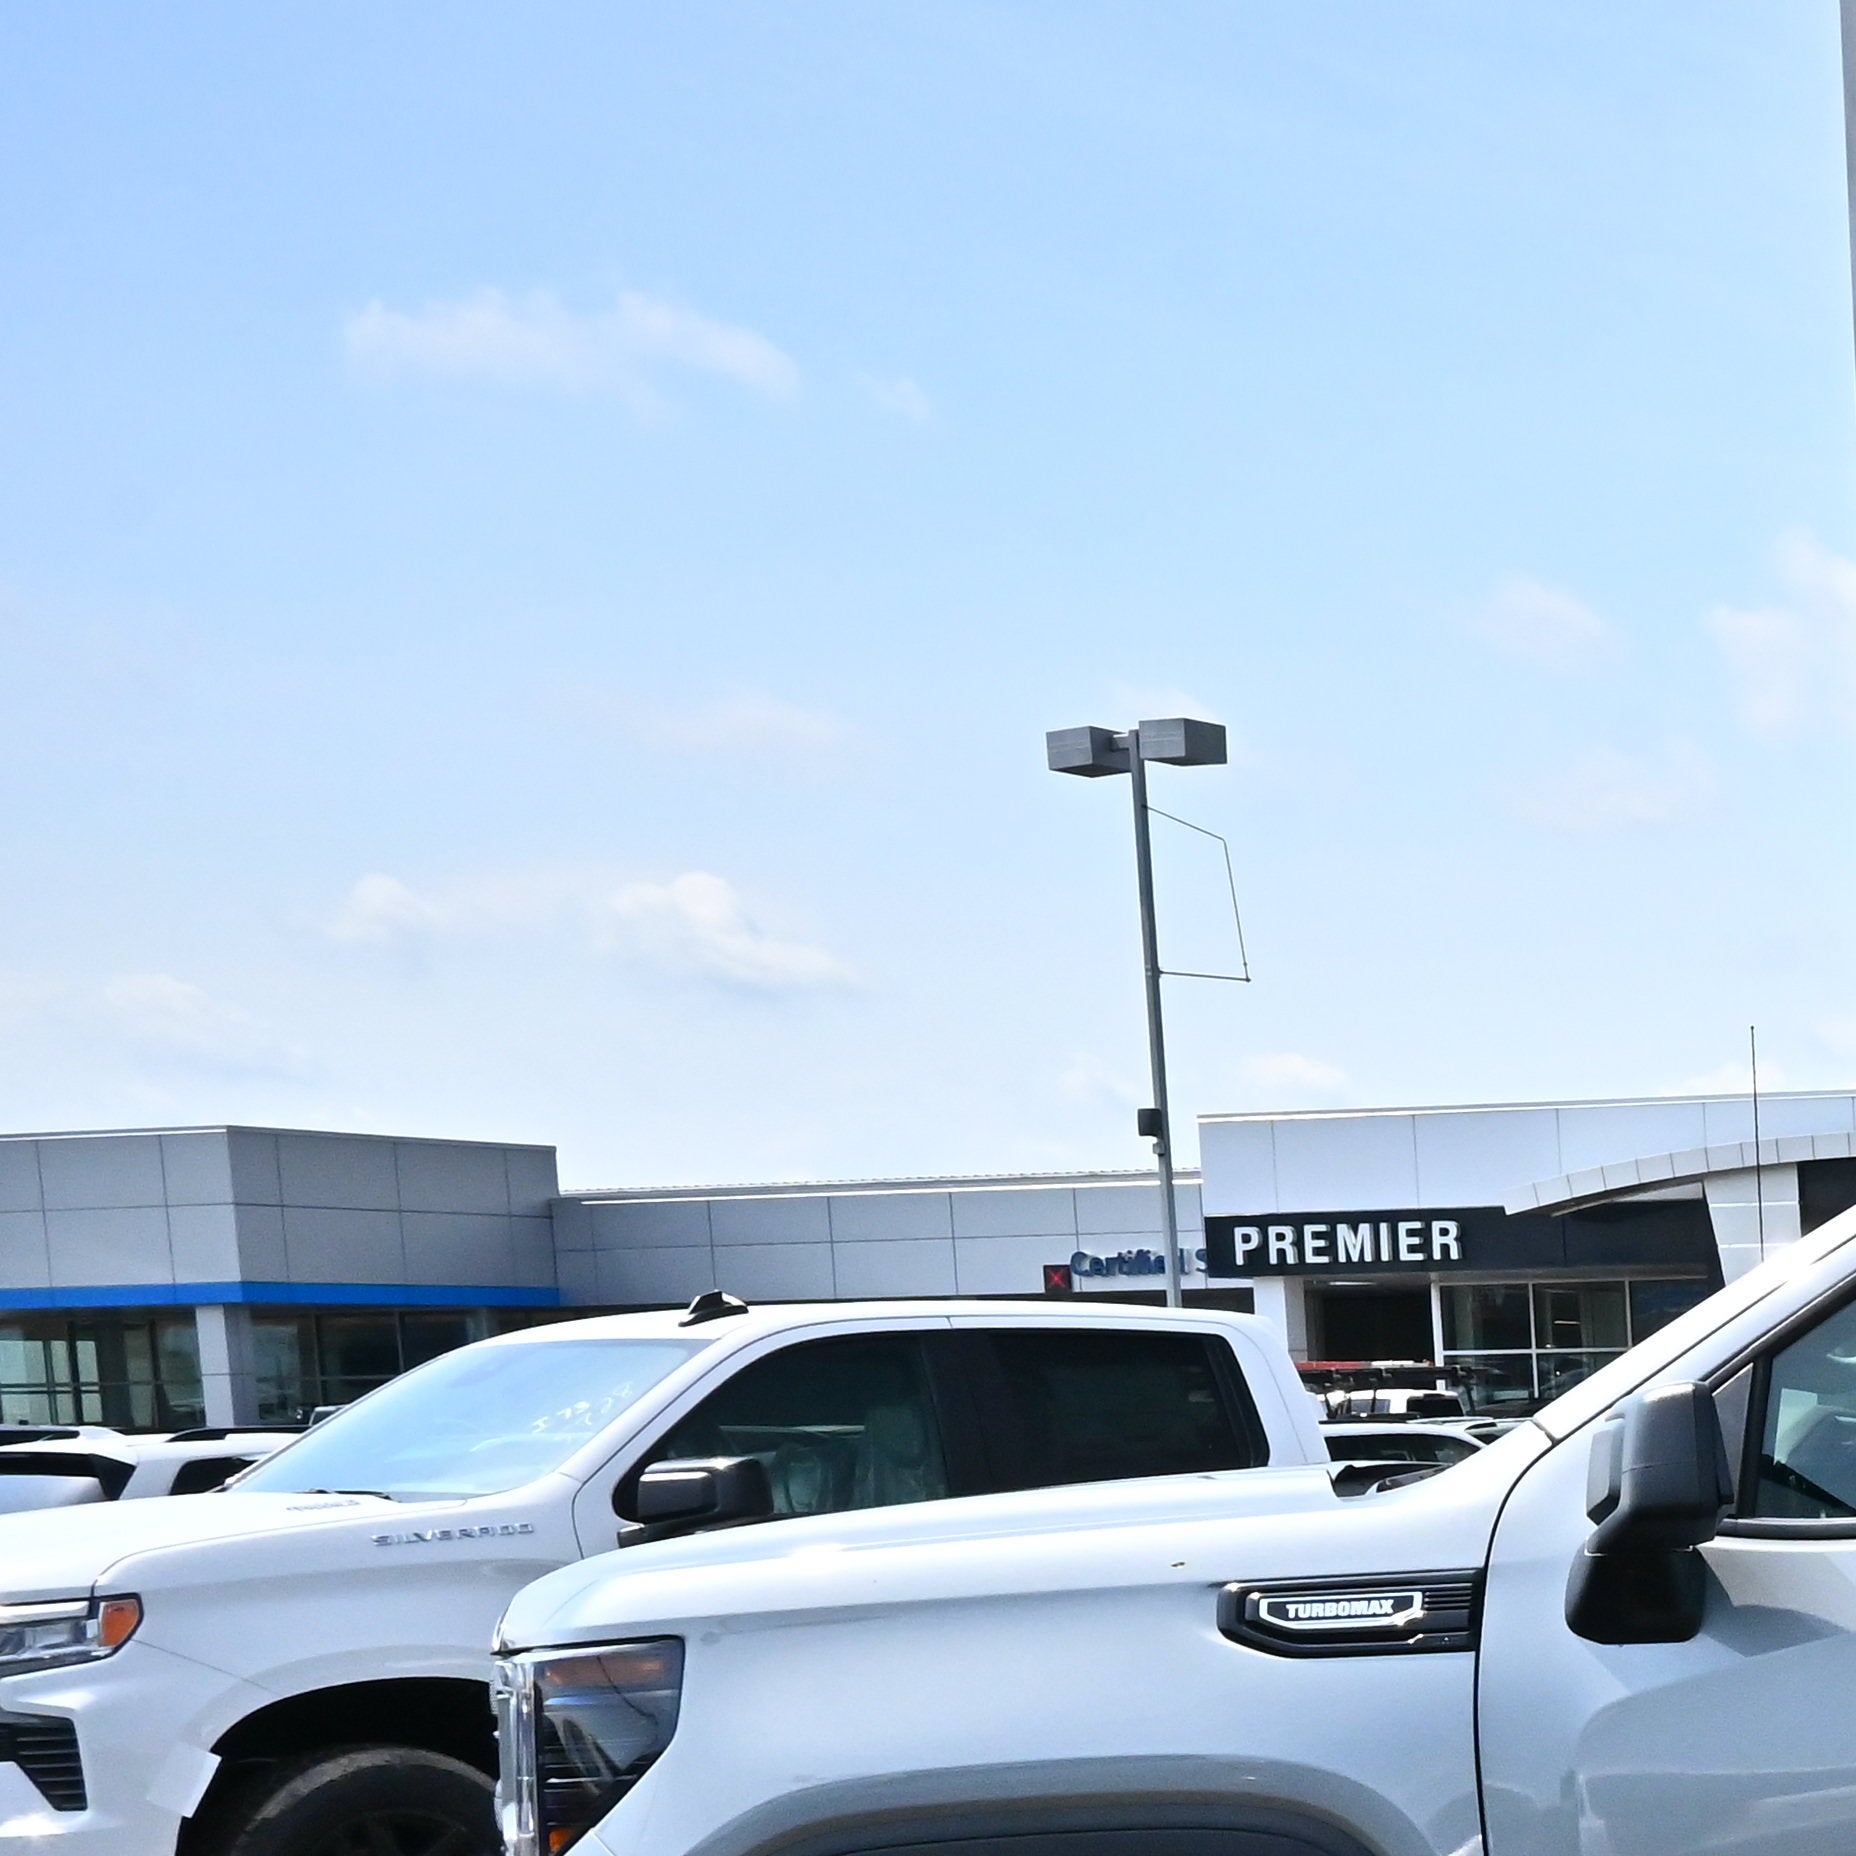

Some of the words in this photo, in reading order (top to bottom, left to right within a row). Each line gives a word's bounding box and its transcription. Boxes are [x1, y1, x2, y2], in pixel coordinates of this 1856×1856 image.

[1233, 1220, 1462, 1266] PREMIER
[370, 1522, 534, 1547] SILVERADO
[1286, 1598, 1395, 1620] TURBOMAX
